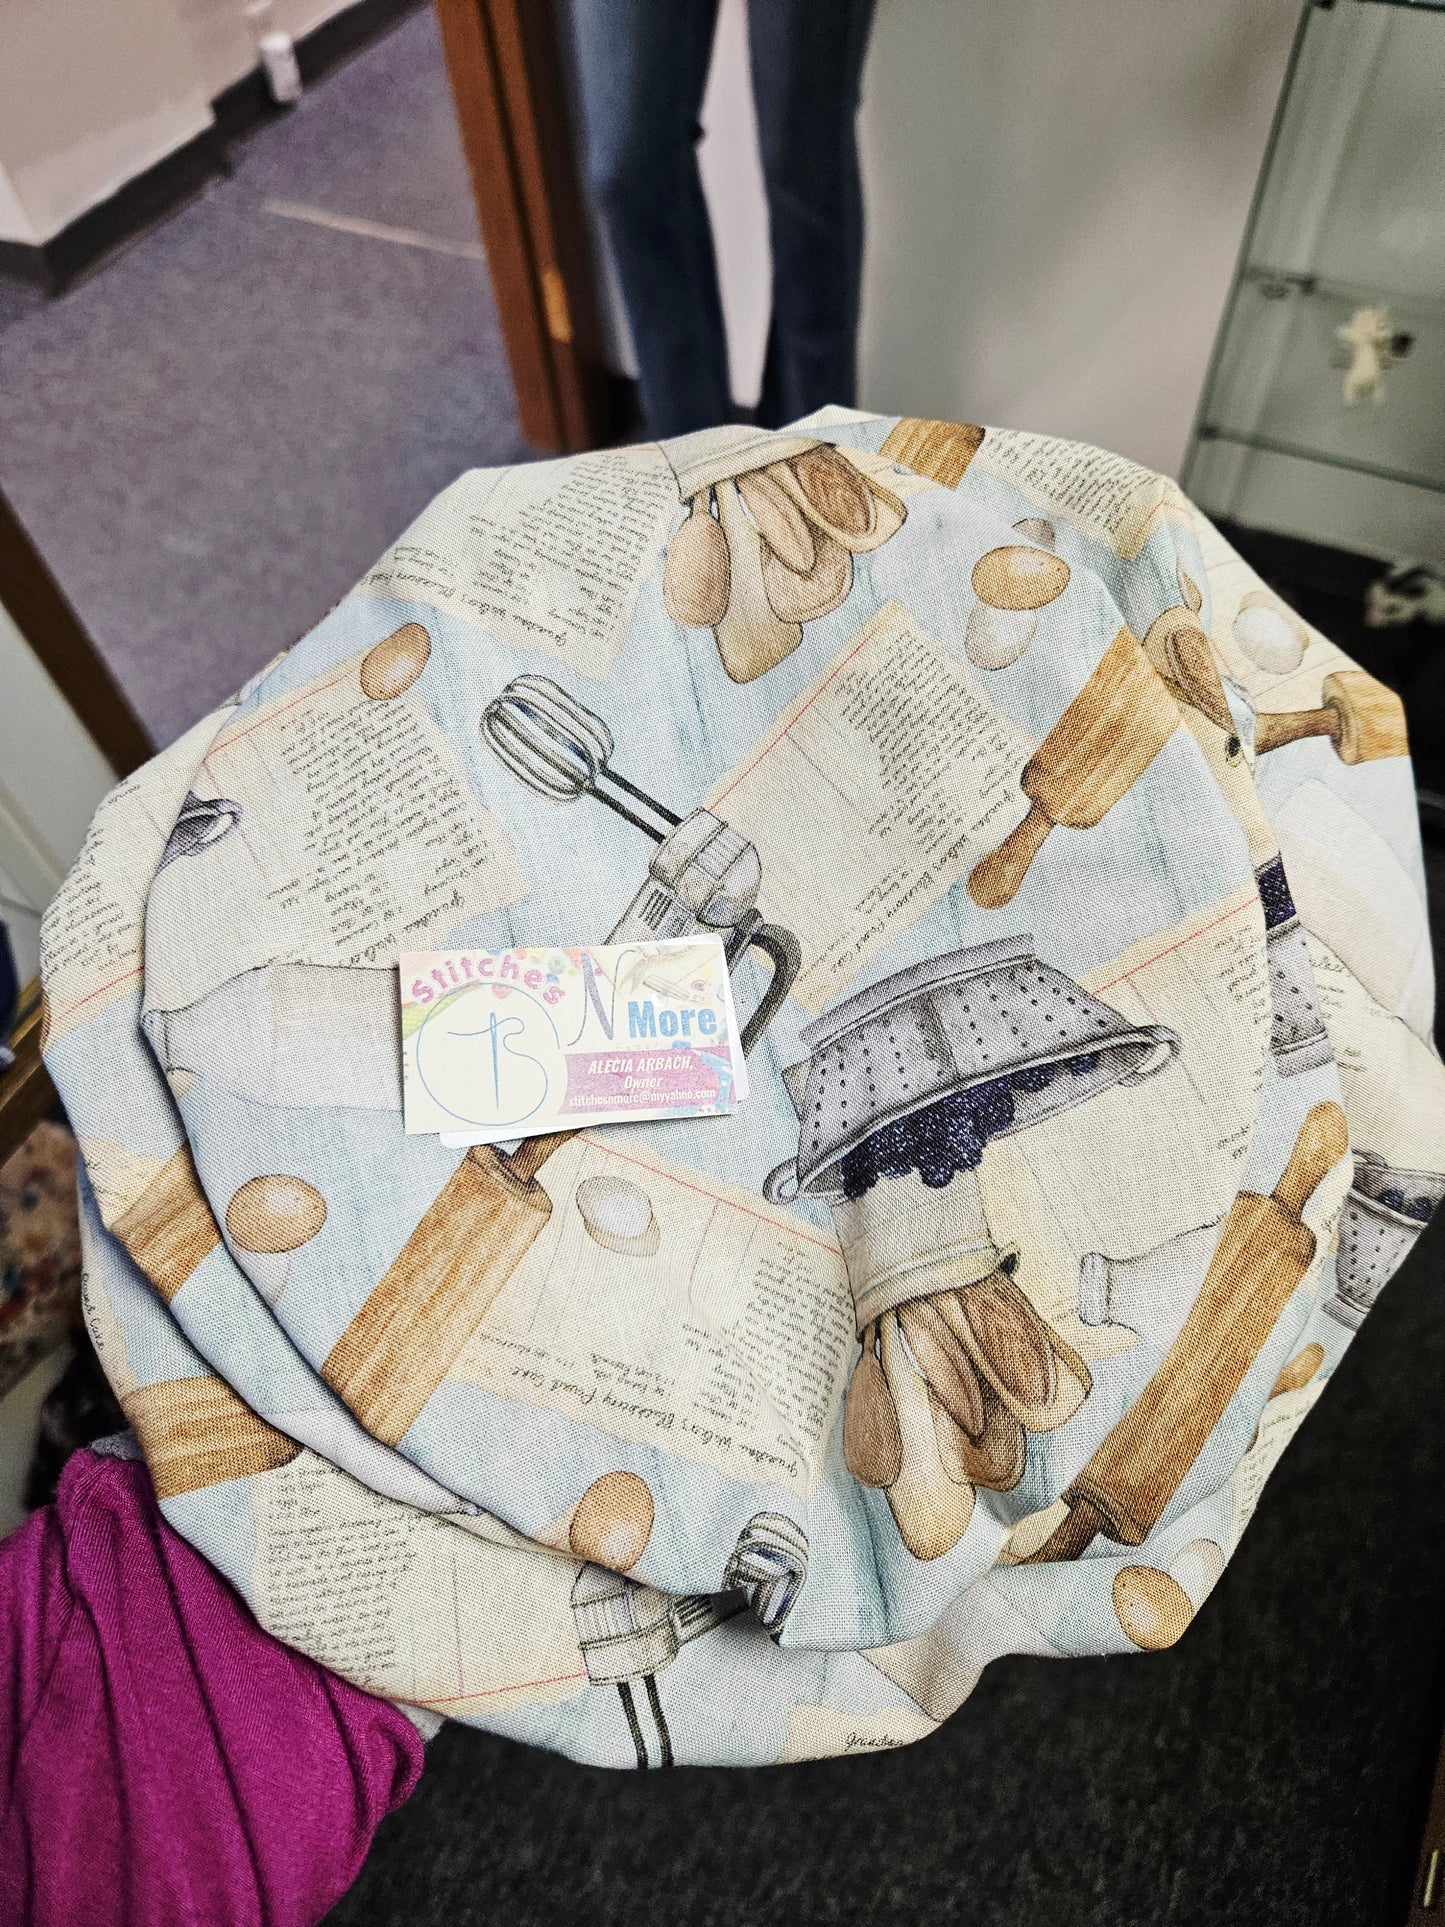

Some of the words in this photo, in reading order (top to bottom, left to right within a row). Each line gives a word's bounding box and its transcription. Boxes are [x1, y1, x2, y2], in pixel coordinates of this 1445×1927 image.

[411, 954, 565, 1004] Stitches
[567, 949, 637, 1046] N
[628, 1000, 717, 1039] More
[587, 1056, 633, 1074] ALECIA
[624, 1075, 664, 1090] Owner
